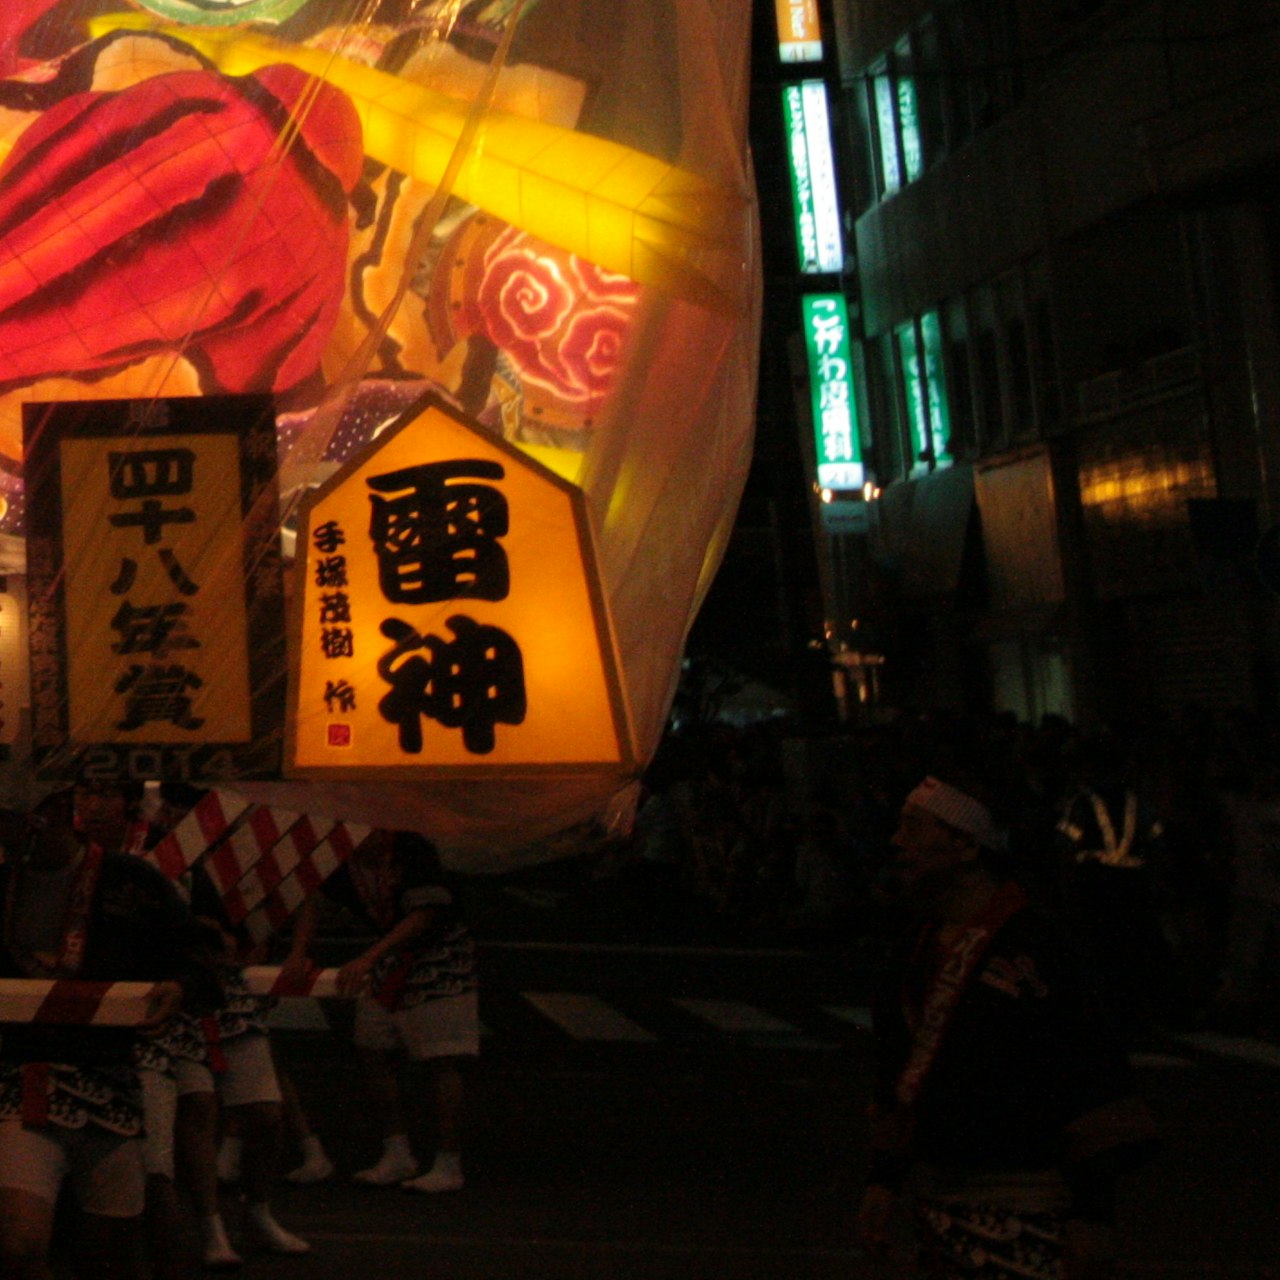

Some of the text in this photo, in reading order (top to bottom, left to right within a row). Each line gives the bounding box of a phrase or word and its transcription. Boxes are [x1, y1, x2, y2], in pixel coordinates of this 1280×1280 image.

[365, 458, 528, 755] 雷神
[324, 679, 357, 714] 作
[82, 748, 234, 781] 2014
